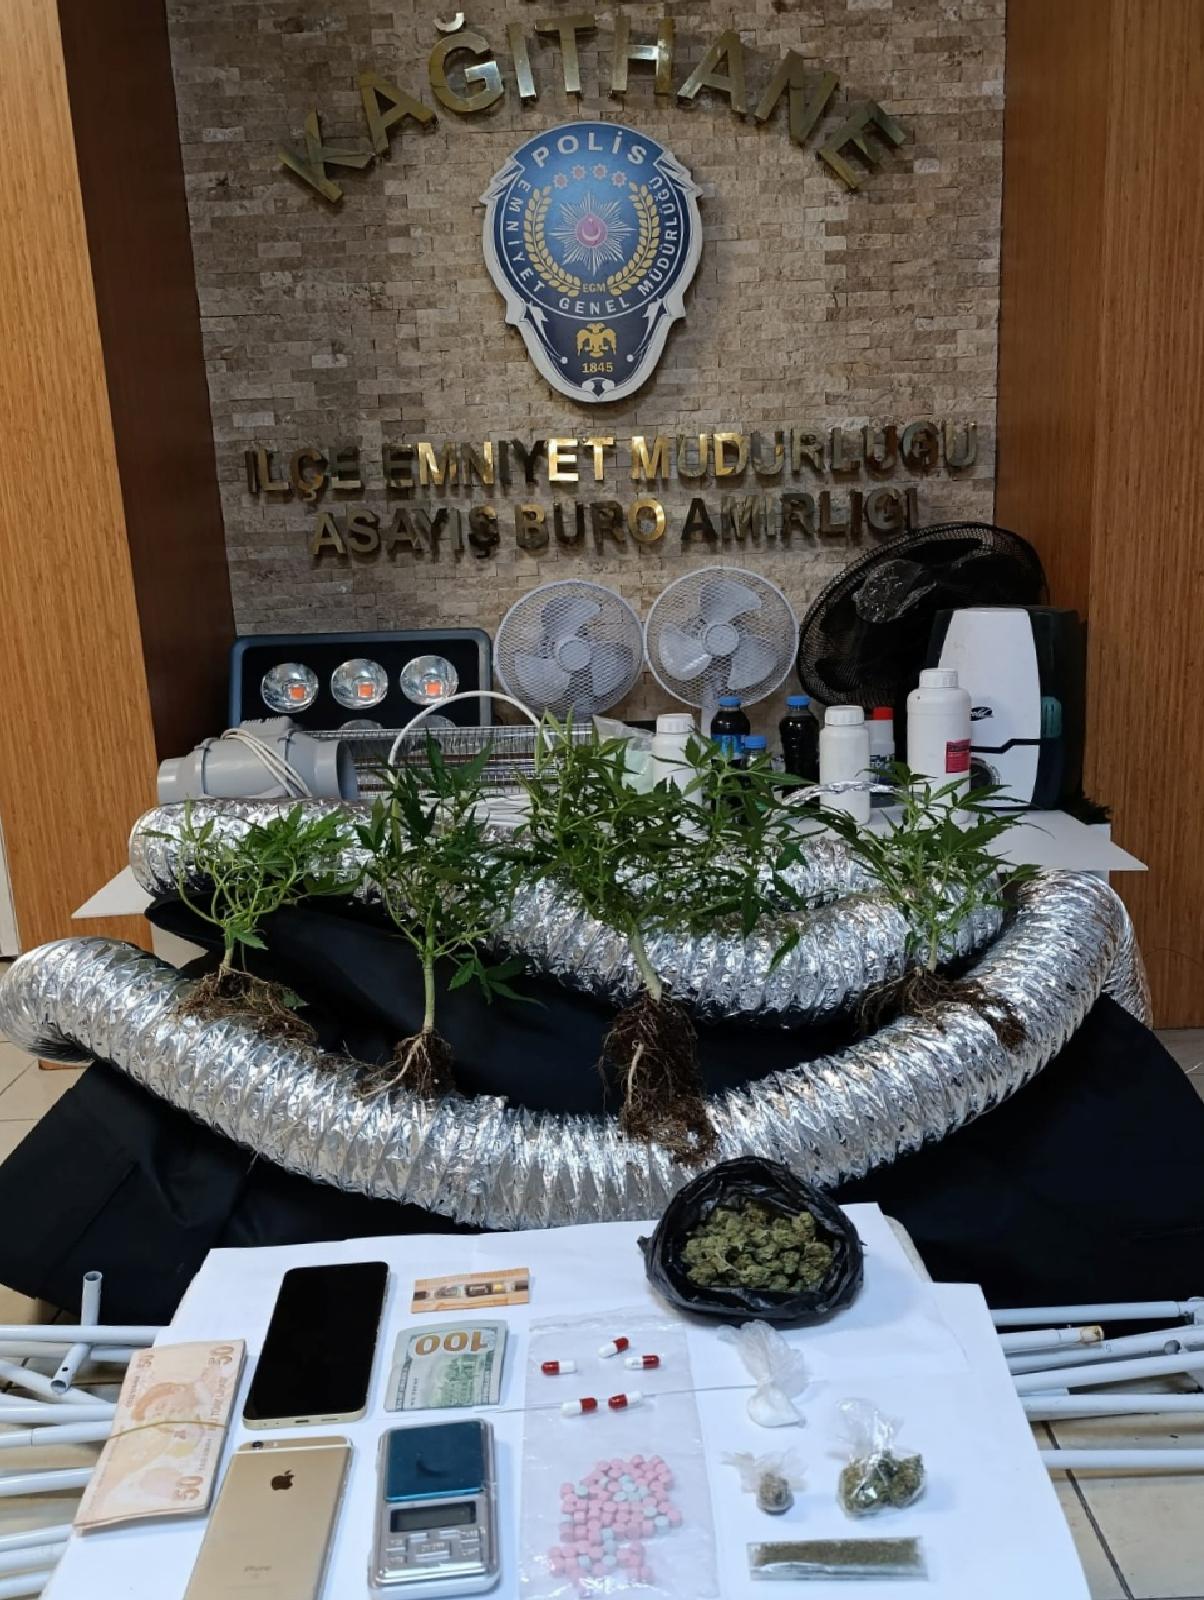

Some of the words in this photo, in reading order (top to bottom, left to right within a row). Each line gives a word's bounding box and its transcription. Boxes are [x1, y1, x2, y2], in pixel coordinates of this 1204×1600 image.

[279, 12, 907, 204] KAĞITHANE
[531, 131, 647, 167] POLİS
[582, 283, 606, 294] EGM
[558, 296, 631, 316] GENEL
[581, 362, 614, 375] 1845
[415, 1331, 488, 1356] 100
[211, 1345, 234, 1365] 50
[177, 1475, 203, 1500] 50
